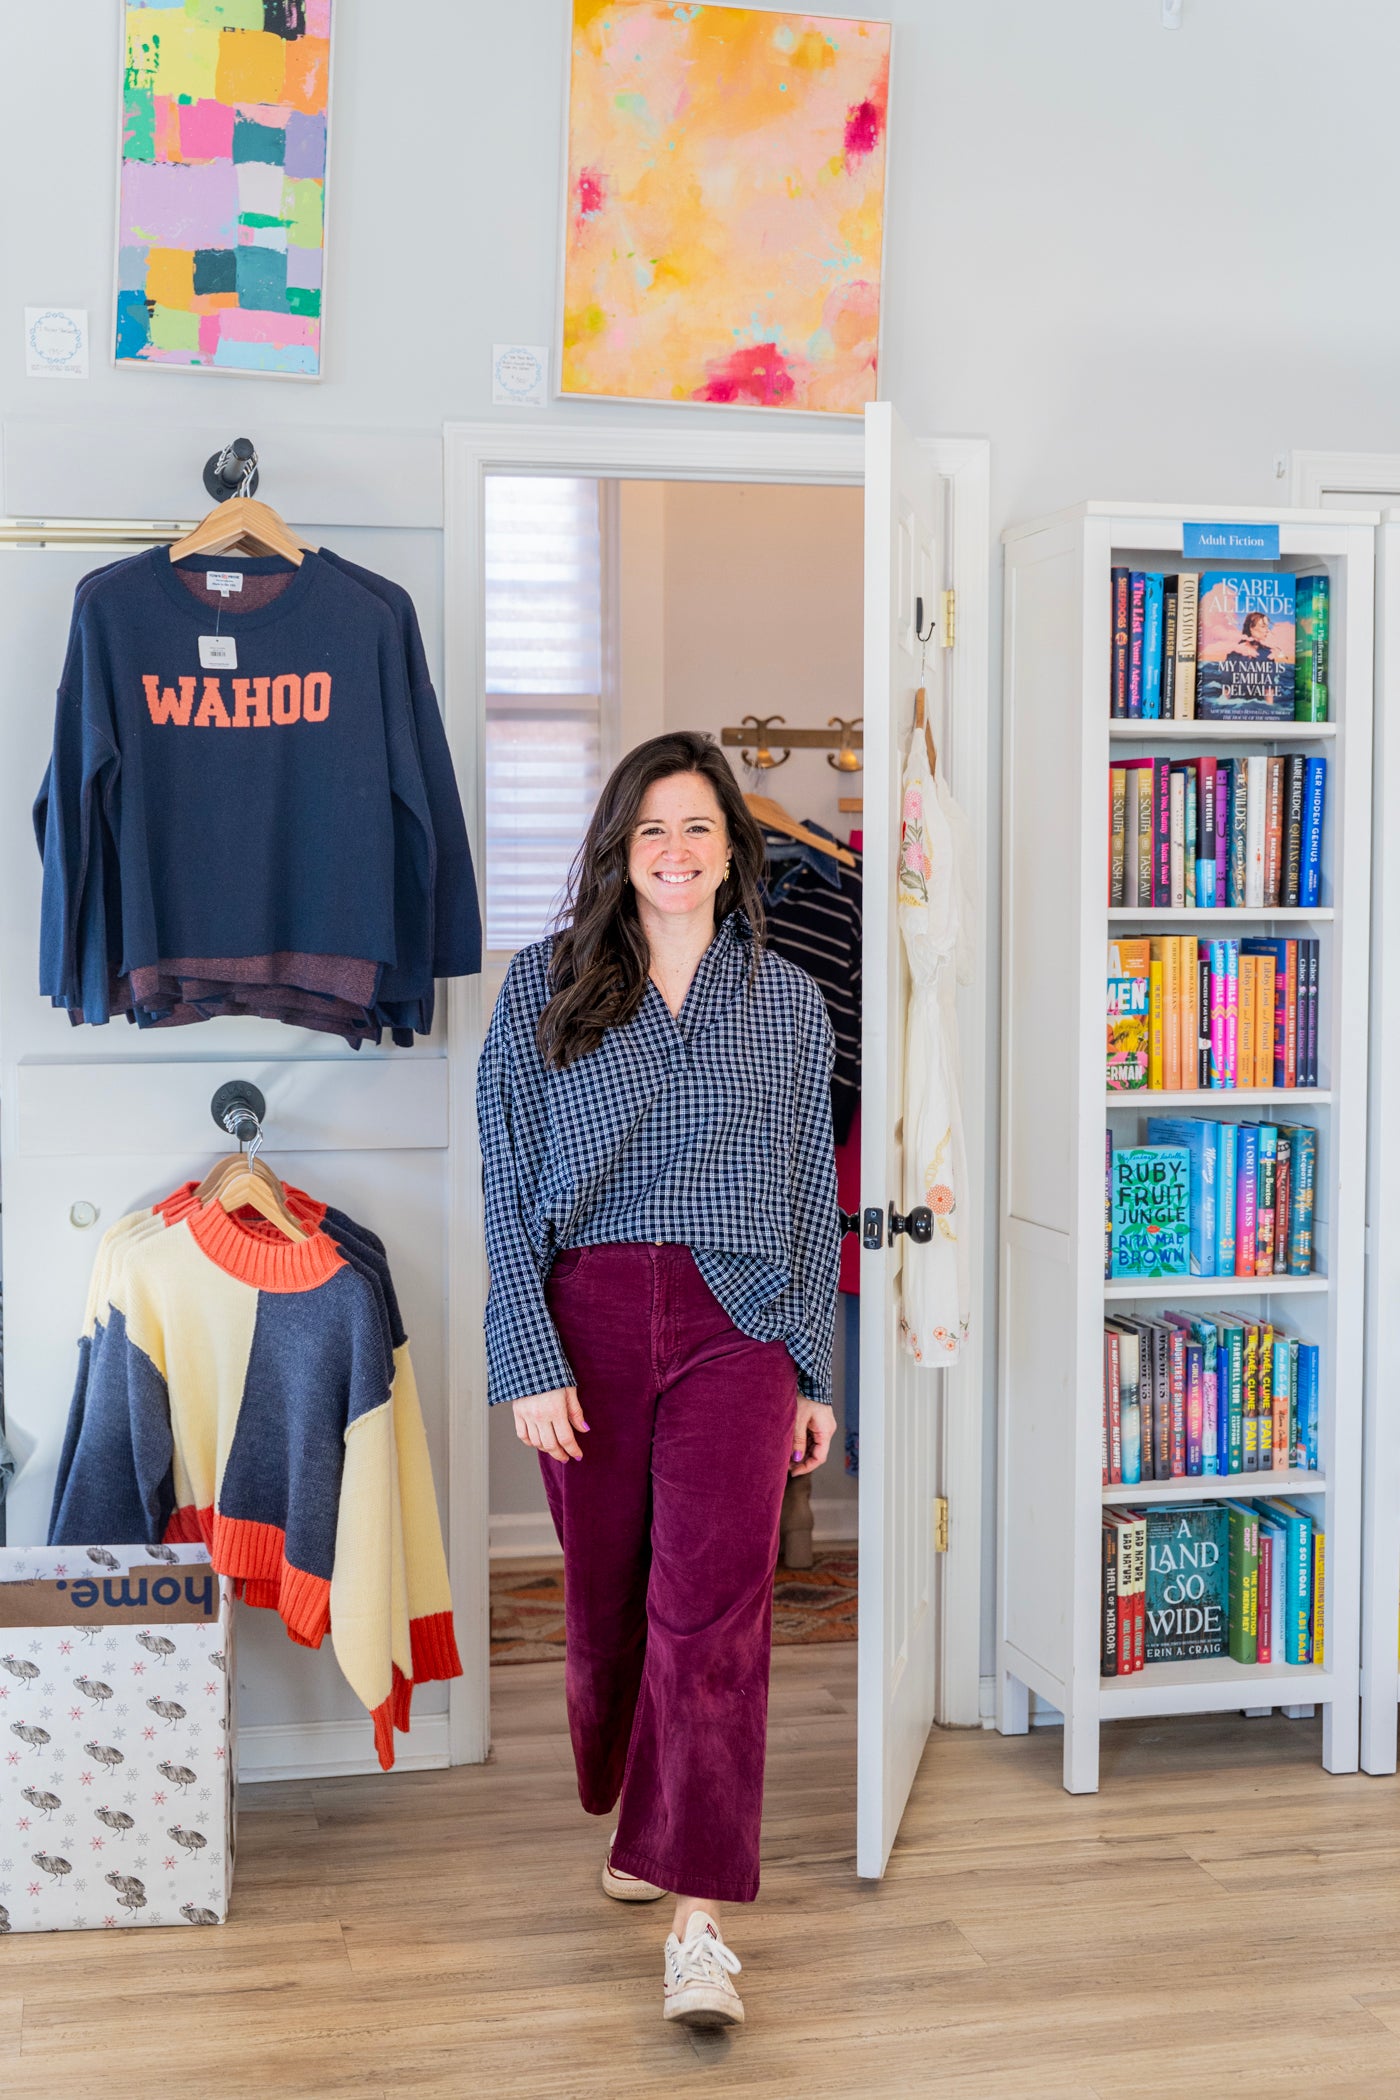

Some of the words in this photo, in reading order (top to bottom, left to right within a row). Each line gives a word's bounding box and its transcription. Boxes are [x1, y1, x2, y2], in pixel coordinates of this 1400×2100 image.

[1199, 535, 1227, 546] Adult
[1229, 535, 1265, 547] Fiction
[1133, 580, 1144, 605] The
[1222, 578, 1284, 598] ISABEL
[1117, 577, 1127, 628] SHEEPDOGS
[1168, 599, 1176, 616] KATE
[1182, 580, 1196, 648] CONFESSIONS
[1208, 596, 1294, 616] ALLENDE
[1166, 619, 1175, 656] ATKINSON
[1218, 662, 1238, 673] MY
[1239, 662, 1274, 673] NAME
[1275, 662, 1286, 673] IS
[1232, 673, 1273, 685] EMILIA
[142, 672, 332, 727] WAHOO
[1130, 668, 1141, 706] Adegoke
[1222, 685, 1246, 697] DEL
[1247, 685, 1282, 697] VALLE
[1161, 765, 1168, 777] We
[1293, 757, 1302, 780] MARIE
[1314, 768, 1323, 786] HER
[1113, 779, 1123, 797] THE
[1141, 778, 1150, 797] THE
[1235, 788, 1246, 830] WILDES
[1291, 781, 1302, 821] BENEDICT
[1312, 788, 1322, 826] HIDDEN
[1113, 798, 1123, 833] SOUTH
[1141, 798, 1150, 833] SOUTH
[1160, 812, 1168, 835] Bunny
[1311, 828, 1320, 863] GENIUS
[1113, 855, 1123, 881] TASH
[1141, 855, 1150, 880] TASH
[1216, 949, 1224, 1003] SHOPGIRLS
[1228, 949, 1236, 1003] SHOPGIRLS
[1243, 962, 1251, 987] Libby
[1262, 962, 1271, 987] Libby
[1309, 958, 1317, 982] Chloe
[1263, 988, 1271, 1007] Lost
[1243, 1022, 1251, 1050] Found
[1262, 1022, 1270, 1050] Found
[1247, 1135, 1254, 1143] A
[1266, 1139, 1274, 1157] Kira
[1119, 1161, 1187, 1185] RUBY-
[1246, 1145, 1255, 1176] FORTY
[1265, 1158, 1274, 1177] Jane
[1119, 1185, 1185, 1207] FRUIT
[1246, 1177, 1254, 1205] YEAR
[1265, 1177, 1274, 1206] Buxton
[1118, 1207, 1185, 1224] JUNGLE
[1245, 1206, 1254, 1227] KISS
[1118, 1235, 1148, 1249] RITA
[1155, 1232, 1184, 1247] MAE
[1118, 1248, 1184, 1266] BROWN
[1142, 1335, 1151, 1362] ONE
[1159, 1334, 1168, 1361] ONE
[1174, 1337, 1183, 1380] DAUGHTERS
[1142, 1364, 1150, 1378] OF
[1159, 1364, 1168, 1378] OF
[1232, 1342, 1241, 1382] FAREWELL
[1142, 1383, 1151, 1399] US
[1159, 1382, 1168, 1399] US
[1174, 1382, 1183, 1391] OF
[1191, 1386, 1198, 1397] WE
[1232, 1384, 1241, 1404] TOUR
[1247, 1378, 1256, 1411] CLUNE
[1262, 1378, 1271, 1409] CLUNE
[1160, 1404, 1168, 1424] DAN
[1174, 1392, 1183, 1431] SHANDONG
[1160, 1428, 1168, 1461] CHAON
[1245, 1421, 1256, 1451] PAN
[1260, 1419, 1272, 1449] PAN
[1135, 1530, 1144, 1546] BAD
[1177, 1519, 1192, 1539] A
[1299, 1524, 1307, 1543] AND
[1123, 1533, 1132, 1551] BAD
[1299, 1547, 1307, 1561] SO
[1123, 1553, 1132, 1585] NATURE
[1135, 1550, 1144, 1582] NATURE
[1150, 1542, 1219, 1574] LAND
[1107, 1567, 1116, 1594] HALL
[1164, 1574, 1205, 1604] SO
[1243, 1577, 1249, 1588] OF
[1299, 1569, 1307, 1597] ROAR
[56, 1576, 213, 1615] home.
[1107, 1596, 1114, 1606] OF
[1106, 1609, 1115, 1655] MIRRORS
[1147, 1606, 1221, 1636] WIDE
[1299, 1610, 1307, 1630] ABI
[1147, 1647, 1172, 1658] ERIN
[1176, 1646, 1186, 1656] A.
[1188, 1643, 1221, 1655] CRAIG
